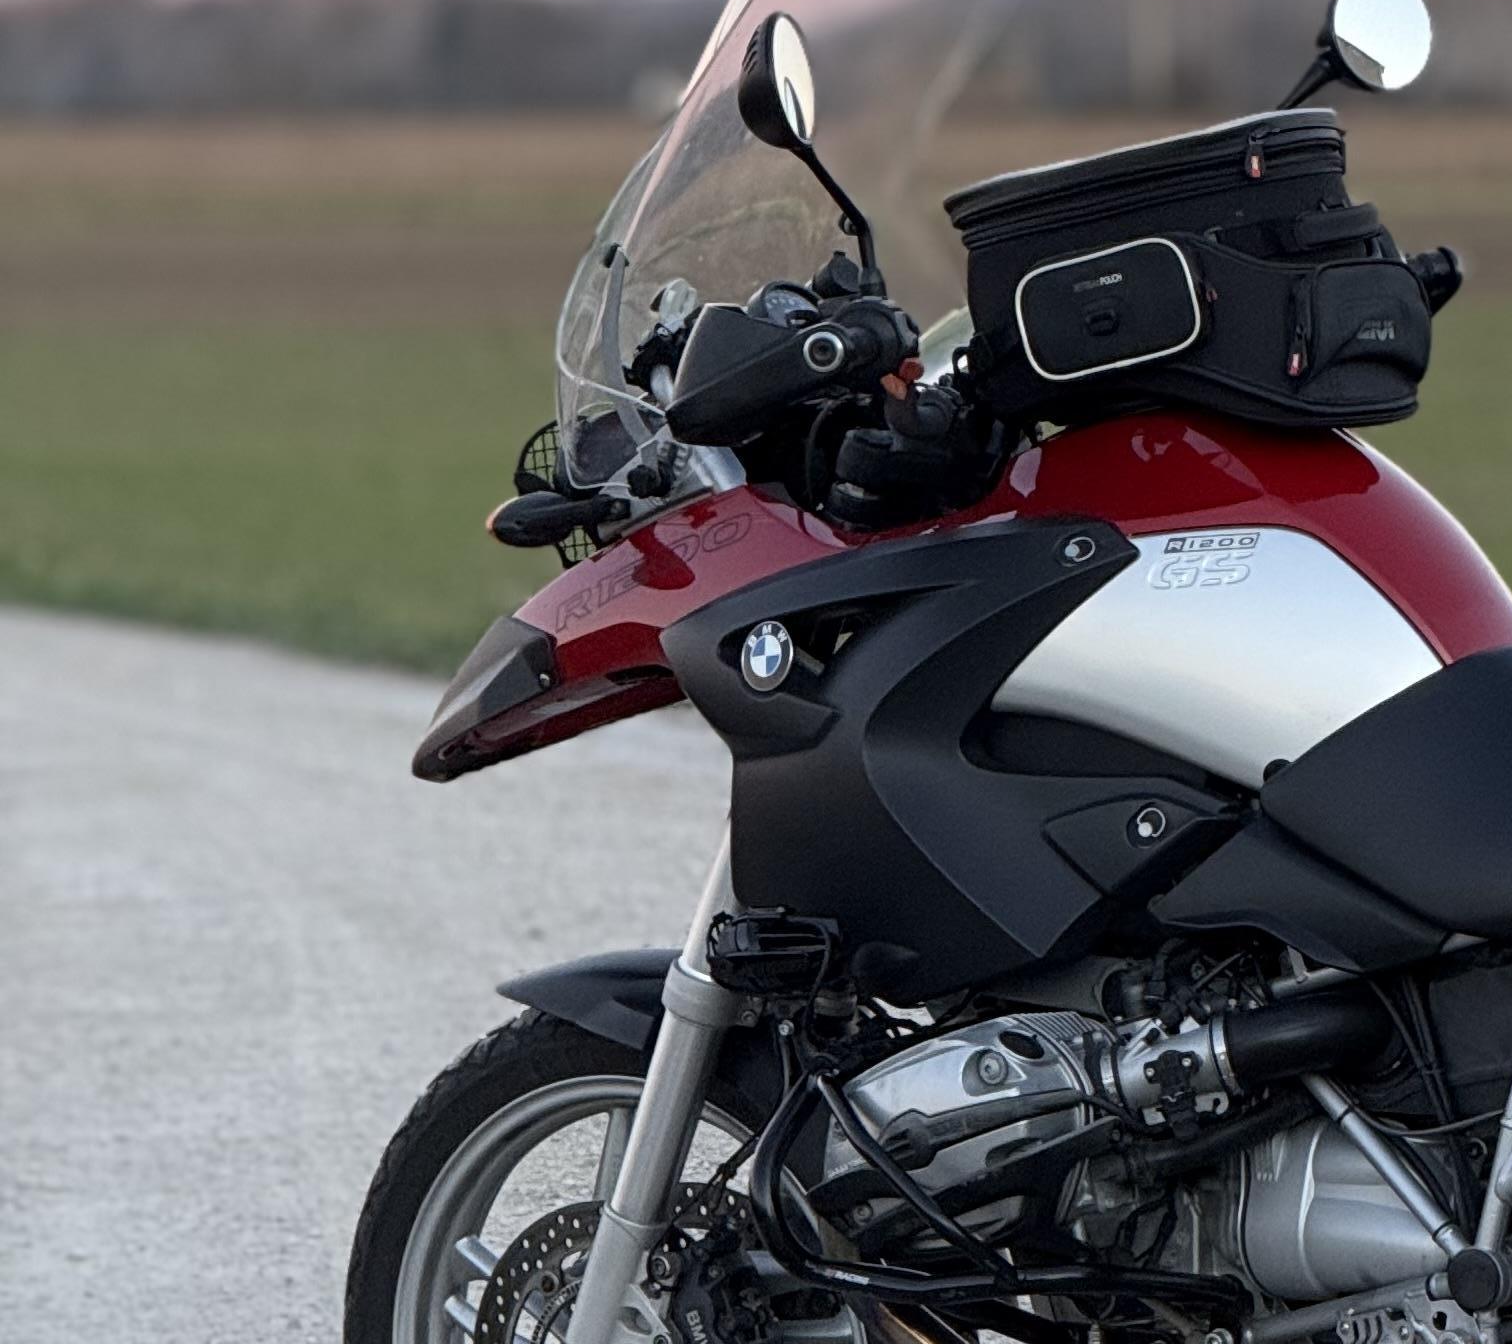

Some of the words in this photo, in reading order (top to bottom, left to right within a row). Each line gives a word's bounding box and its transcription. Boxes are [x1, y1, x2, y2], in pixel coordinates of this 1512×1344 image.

[1164, 534, 1259, 554] R1200
[1147, 552, 1254, 590] GS
[747, 623, 789, 648] BMW
